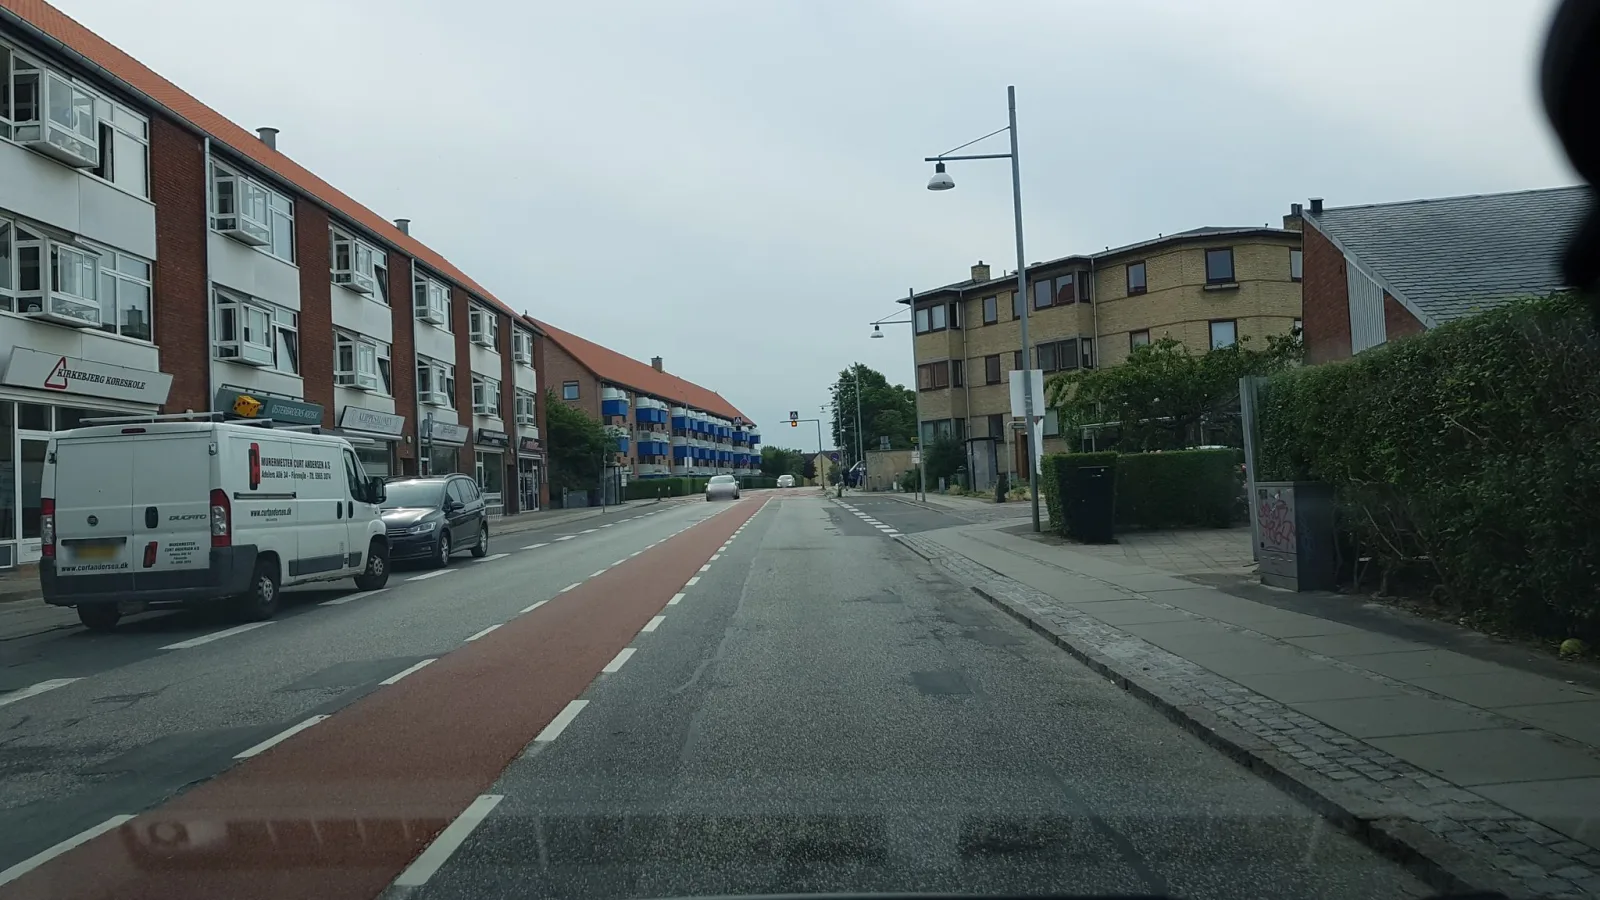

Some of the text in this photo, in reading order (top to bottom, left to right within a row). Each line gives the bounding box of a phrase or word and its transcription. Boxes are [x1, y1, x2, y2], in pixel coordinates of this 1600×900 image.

[57, 368, 146, 390] KIRKEBJERG KØRESKOLE
[304, 409, 320, 419] KIOSK
[261, 457, 293, 467] MURERMESTER
[293, 459, 304, 468] CURT
[305, 460, 324, 469] ANDERSEN
